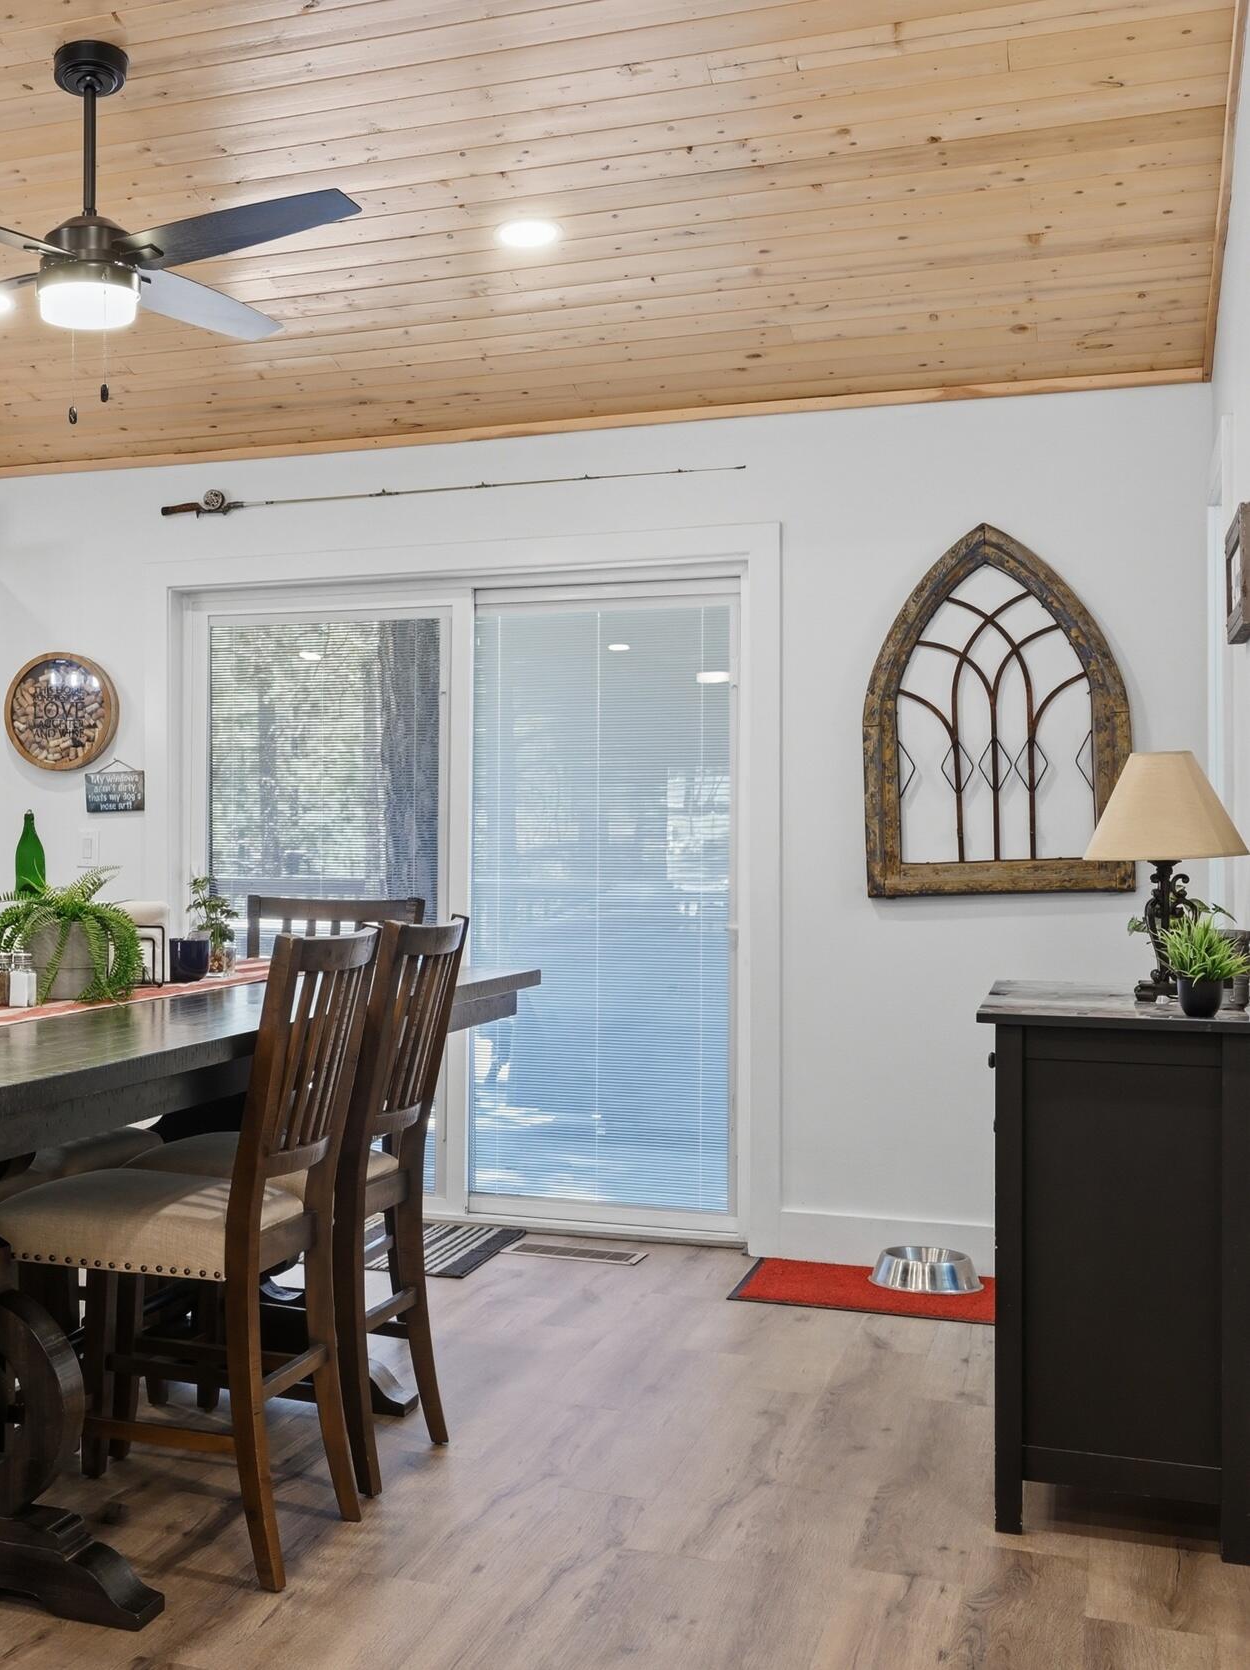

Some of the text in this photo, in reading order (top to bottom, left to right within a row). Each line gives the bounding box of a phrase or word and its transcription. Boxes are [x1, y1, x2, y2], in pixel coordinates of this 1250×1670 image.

[34, 701, 85, 719] LOVE
[34, 729, 56, 739] AND
[118, 783, 136, 792] dirty
[109, 794, 120, 802] my
